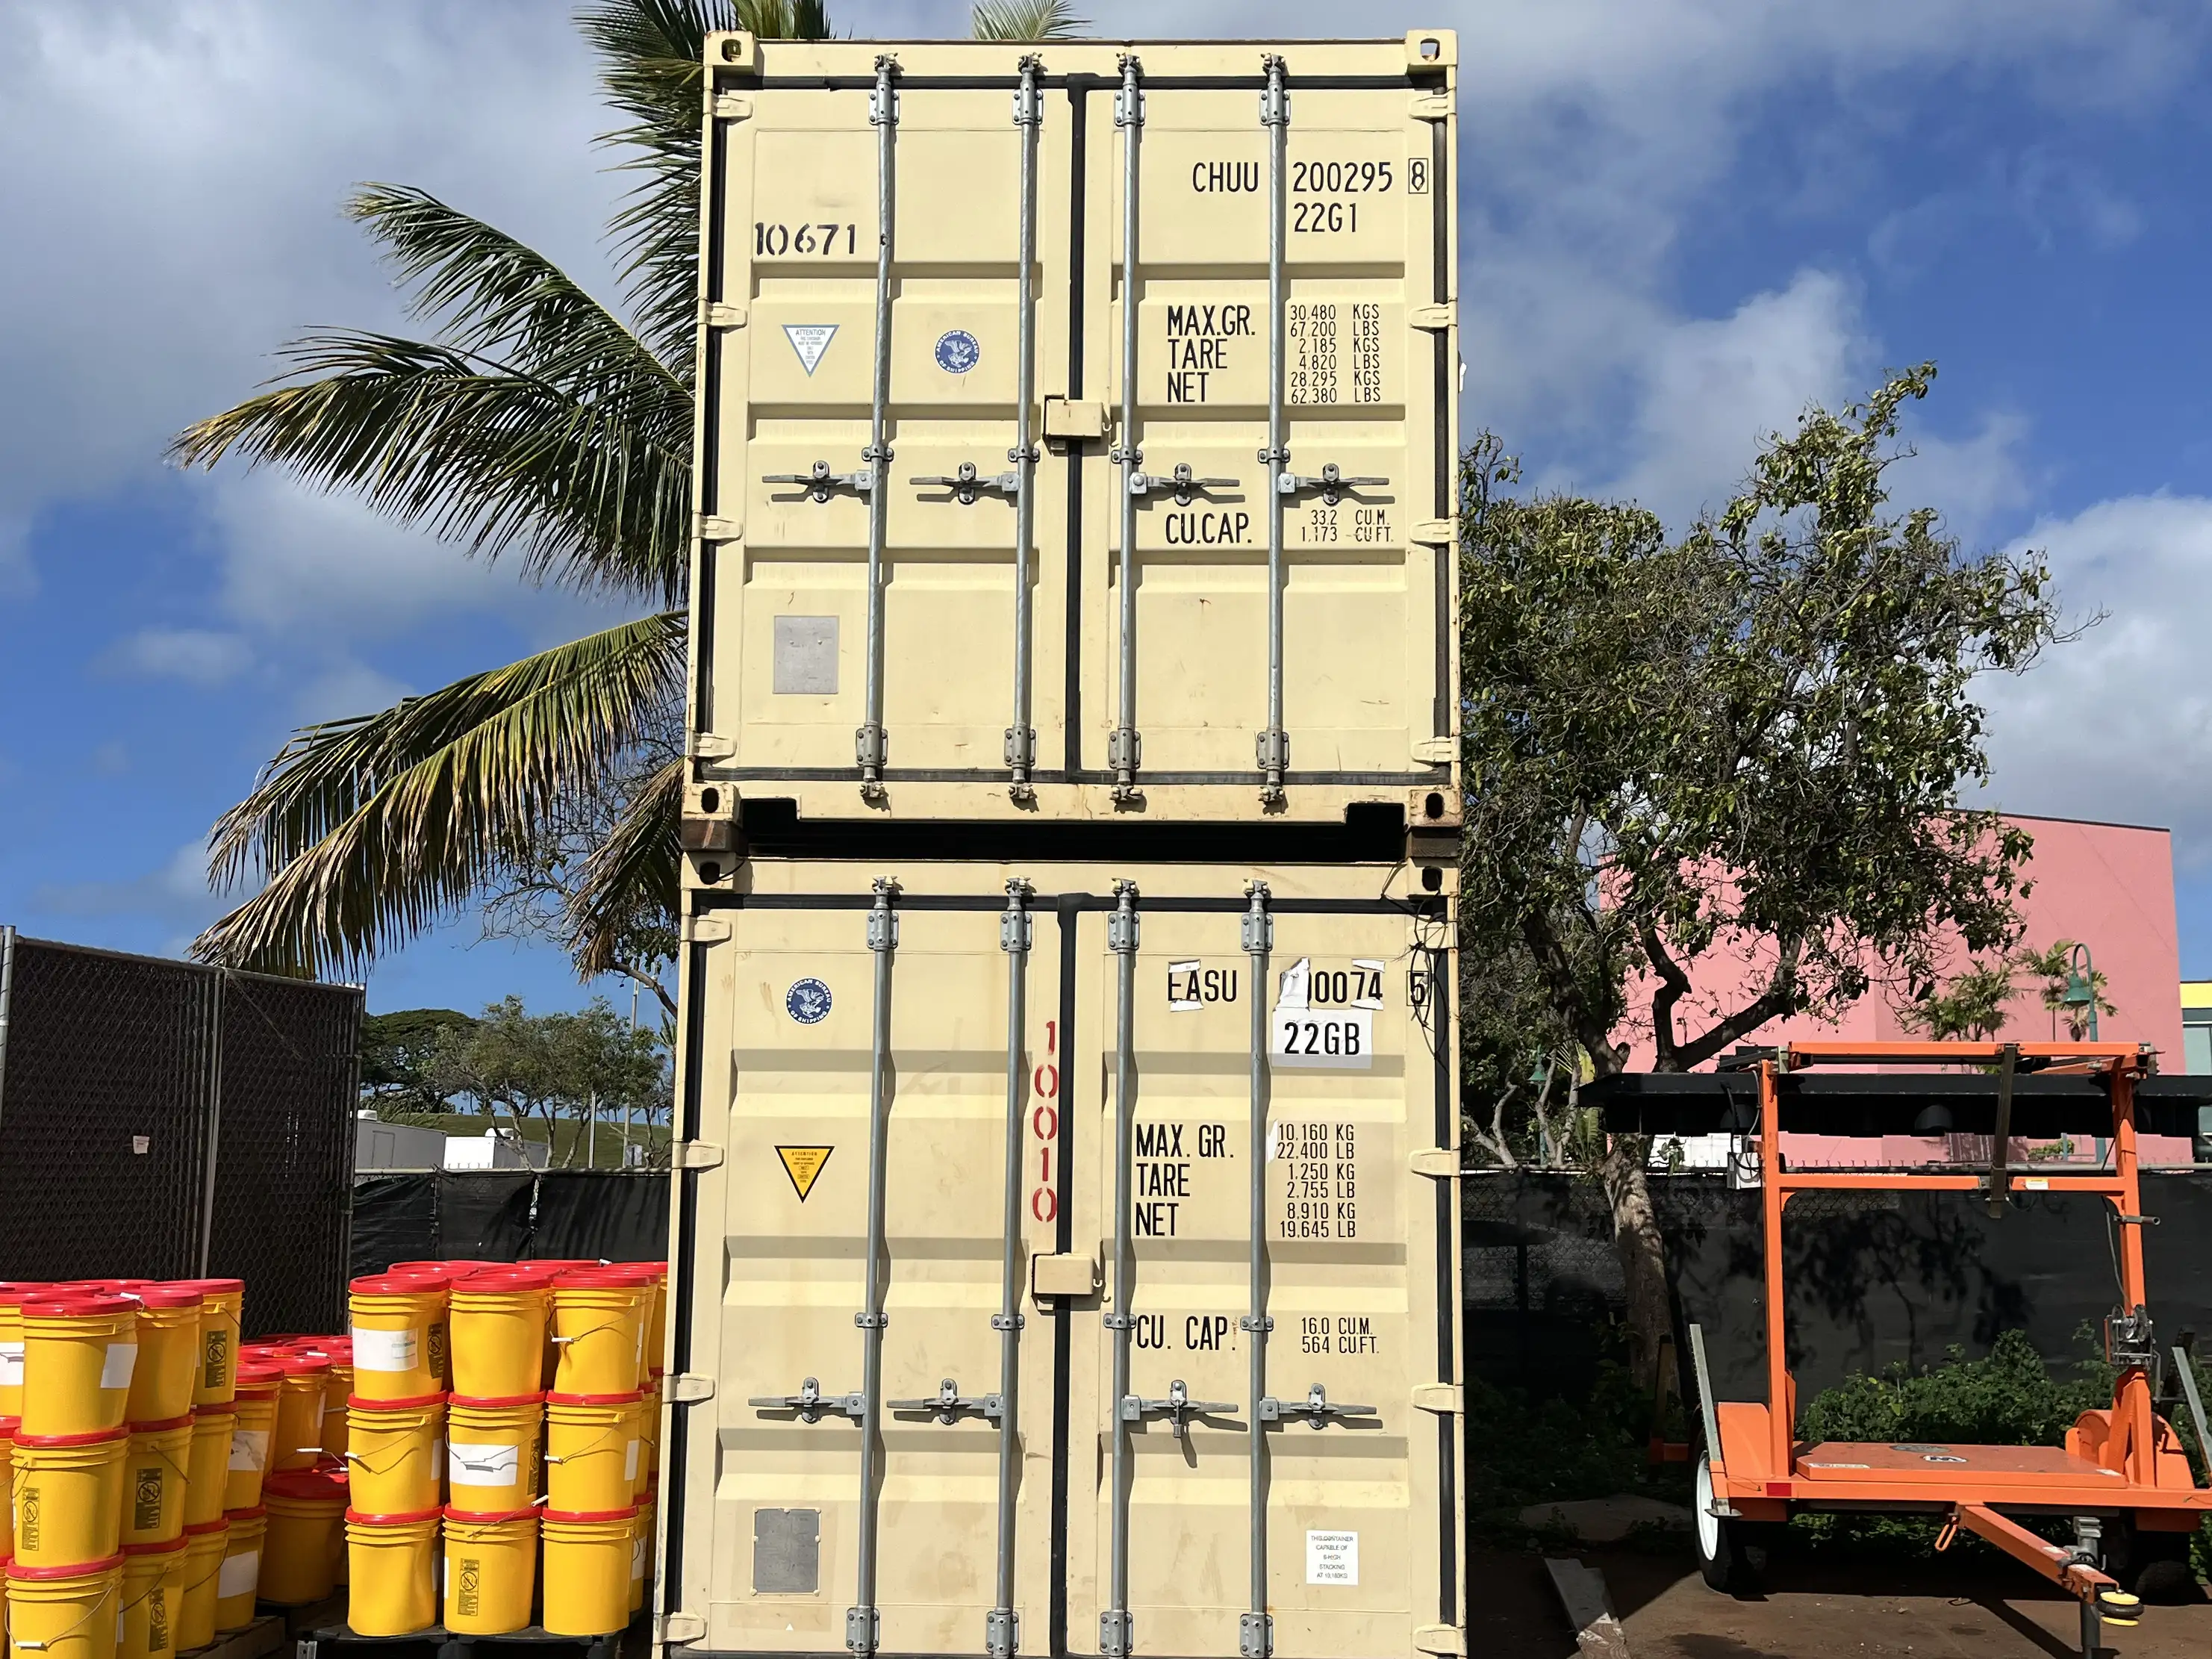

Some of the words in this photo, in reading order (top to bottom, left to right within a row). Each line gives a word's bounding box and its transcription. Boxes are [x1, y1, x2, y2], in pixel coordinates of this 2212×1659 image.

[1192, 162, 1259, 192] CHUU
[1293, 162, 1392, 192] 200295
[1412, 161, 1425, 191] 8
[1294, 202, 1356, 232] 22G1
[755, 222, 856, 255] 10671
[1167, 305, 1256, 336] MAX.GR.
[1353, 304, 1380, 320] KGS
[1353, 320, 1380, 336] LBS
[1168, 338, 1228, 369] TARE
[1353, 337, 1380, 353] KGS
[1353, 354, 1380, 369] LBS
[1167, 372, 1209, 402] NET
[1354, 370, 1380, 386] KGS
[1354, 387, 1381, 402] LBS
[1311, 509, 1337, 525] 33.2
[1355, 509, 1390, 525] CU.M.
[1165, 512, 1253, 544] CU.CAP.
[788, 979, 813, 1001] AMERICAN
[814, 980, 832, 1003] BUREAU
[1168, 969, 1237, 1002] EASU
[1284, 1022, 1359, 1055] 22GB
[1032, 1021, 1059, 1222] 10010
[1136, 1124, 1191, 1158] MAX.
[1198, 1124, 1234, 1158] GR.
[1336, 1124, 1354, 1141] KG
[1336, 1142, 1354, 1159] LB
[1136, 1163, 1191, 1197] TARE
[1336, 1163, 1355, 1180] KG
[1336, 1181, 1355, 1198] LB
[1135, 1202, 1180, 1236] NET
[1337, 1202, 1356, 1219] KG
[1337, 1221, 1356, 1238] LB
[1136, 1315, 1171, 1349] CU.
[1186, 1316, 1236, 1351] CAP.
[1301, 1317, 1330, 1334] 16.0
[1338, 1317, 1374, 1334] CU.M.
[1302, 1336, 1330, 1354] 564
